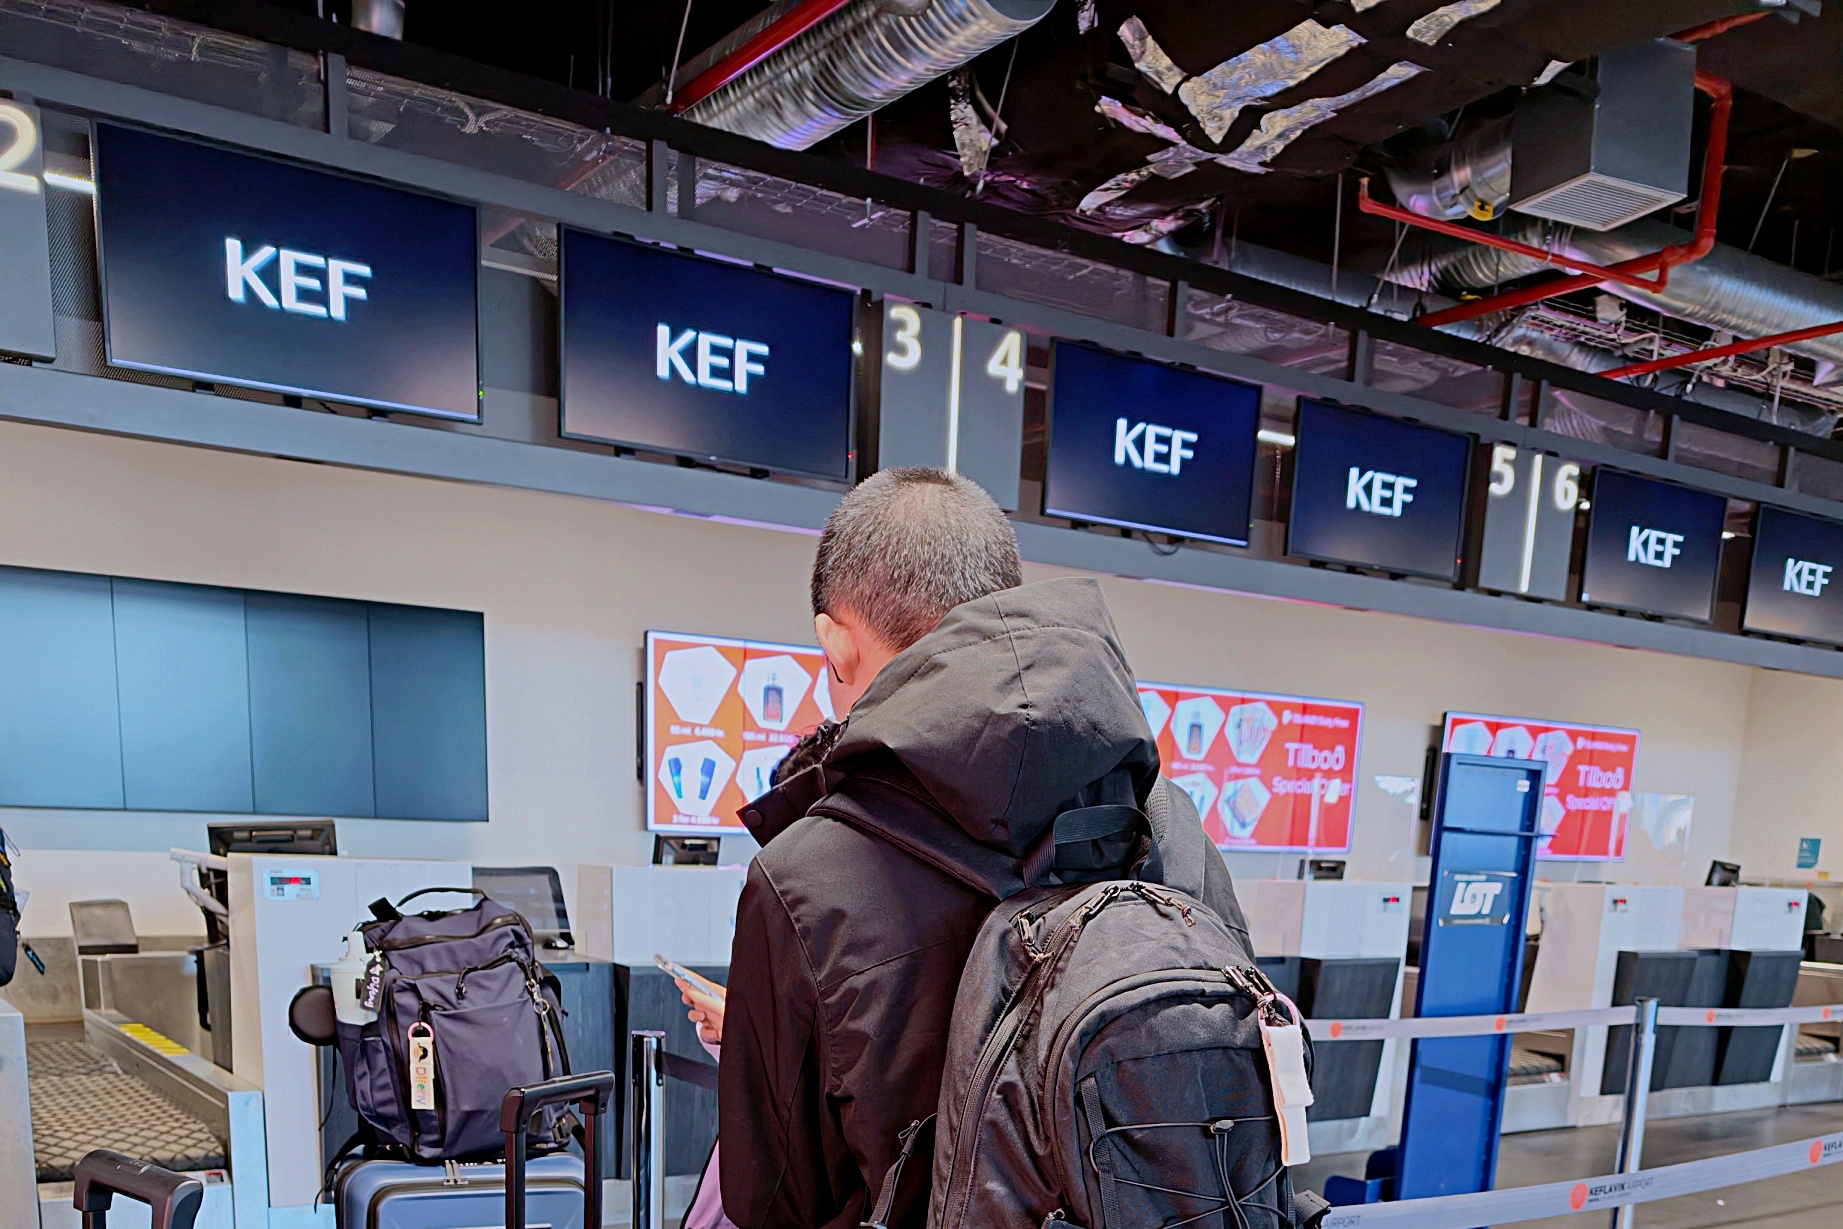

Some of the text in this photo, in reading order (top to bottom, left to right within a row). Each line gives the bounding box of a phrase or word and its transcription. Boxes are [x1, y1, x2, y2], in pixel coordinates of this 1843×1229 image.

[0, 103, 40, 196] 2
[225, 237, 372, 321] KEF
[655, 323, 769, 395] KEF
[887, 306, 922, 371] 3
[986, 331, 1023, 393] 4
[1114, 417, 1198, 478] KEF
[1489, 443, 1516, 497] 5
[1346, 466, 1418, 517] KEF
[1553, 462, 1579, 512] 6
[1627, 525, 1685, 569] KEF
[1783, 558, 1832, 598] KEF
[1450, 882, 1503, 915] LOT
[1588, 1182, 1625, 1197] KEFLAVIK
[1323, 1215, 1361, 1229] AIRPORT
